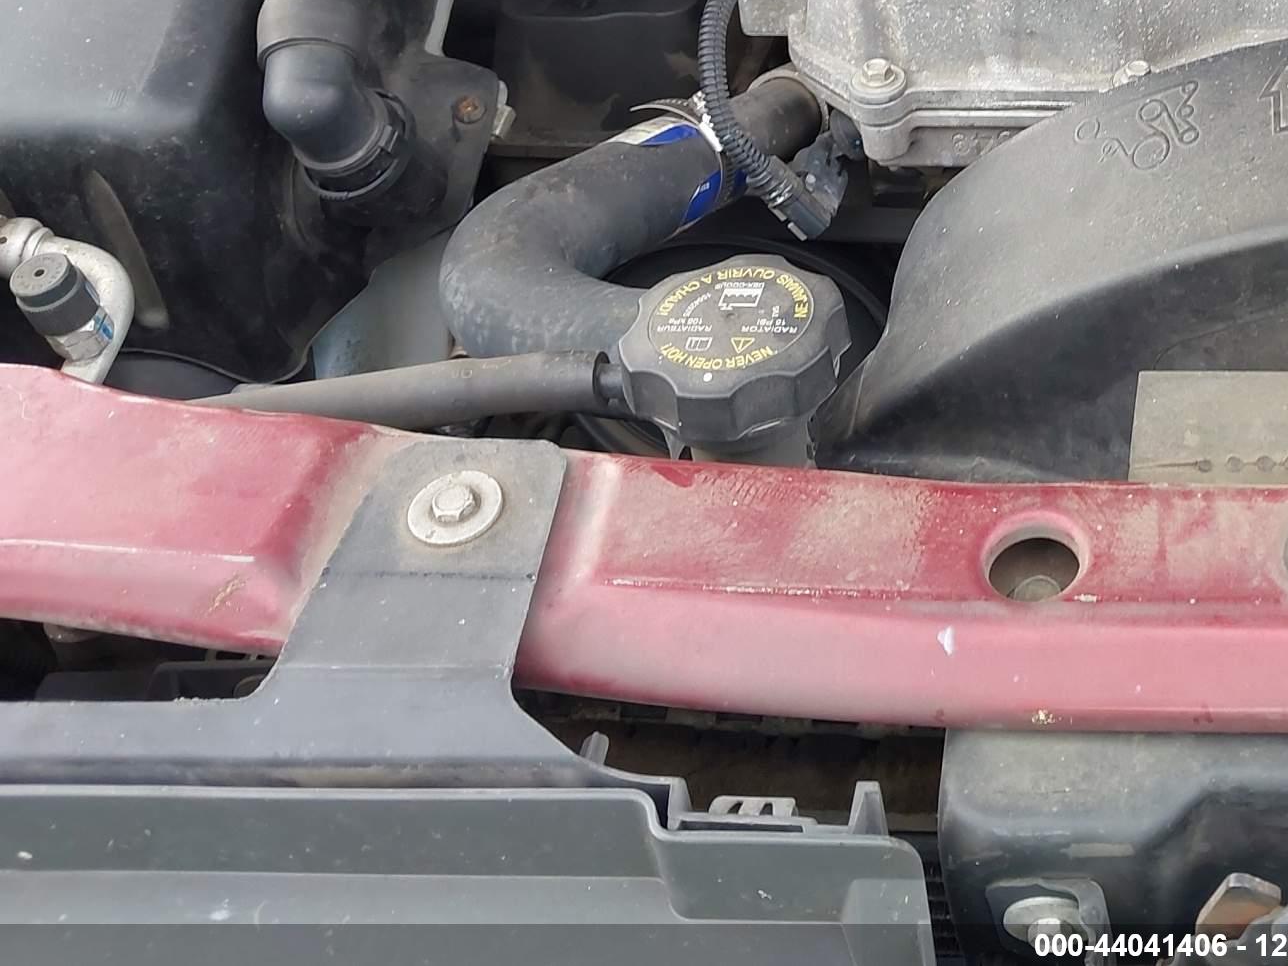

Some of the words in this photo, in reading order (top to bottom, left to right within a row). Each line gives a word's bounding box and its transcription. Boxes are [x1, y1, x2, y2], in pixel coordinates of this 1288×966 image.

[716, 266, 775, 281] OUVRIR
[656, 324, 713, 332] RADIATEUR
[741, 325, 798, 333] RADIATOR
[687, 355, 724, 370] OPEN
[725, 345, 774, 369] NEVER
